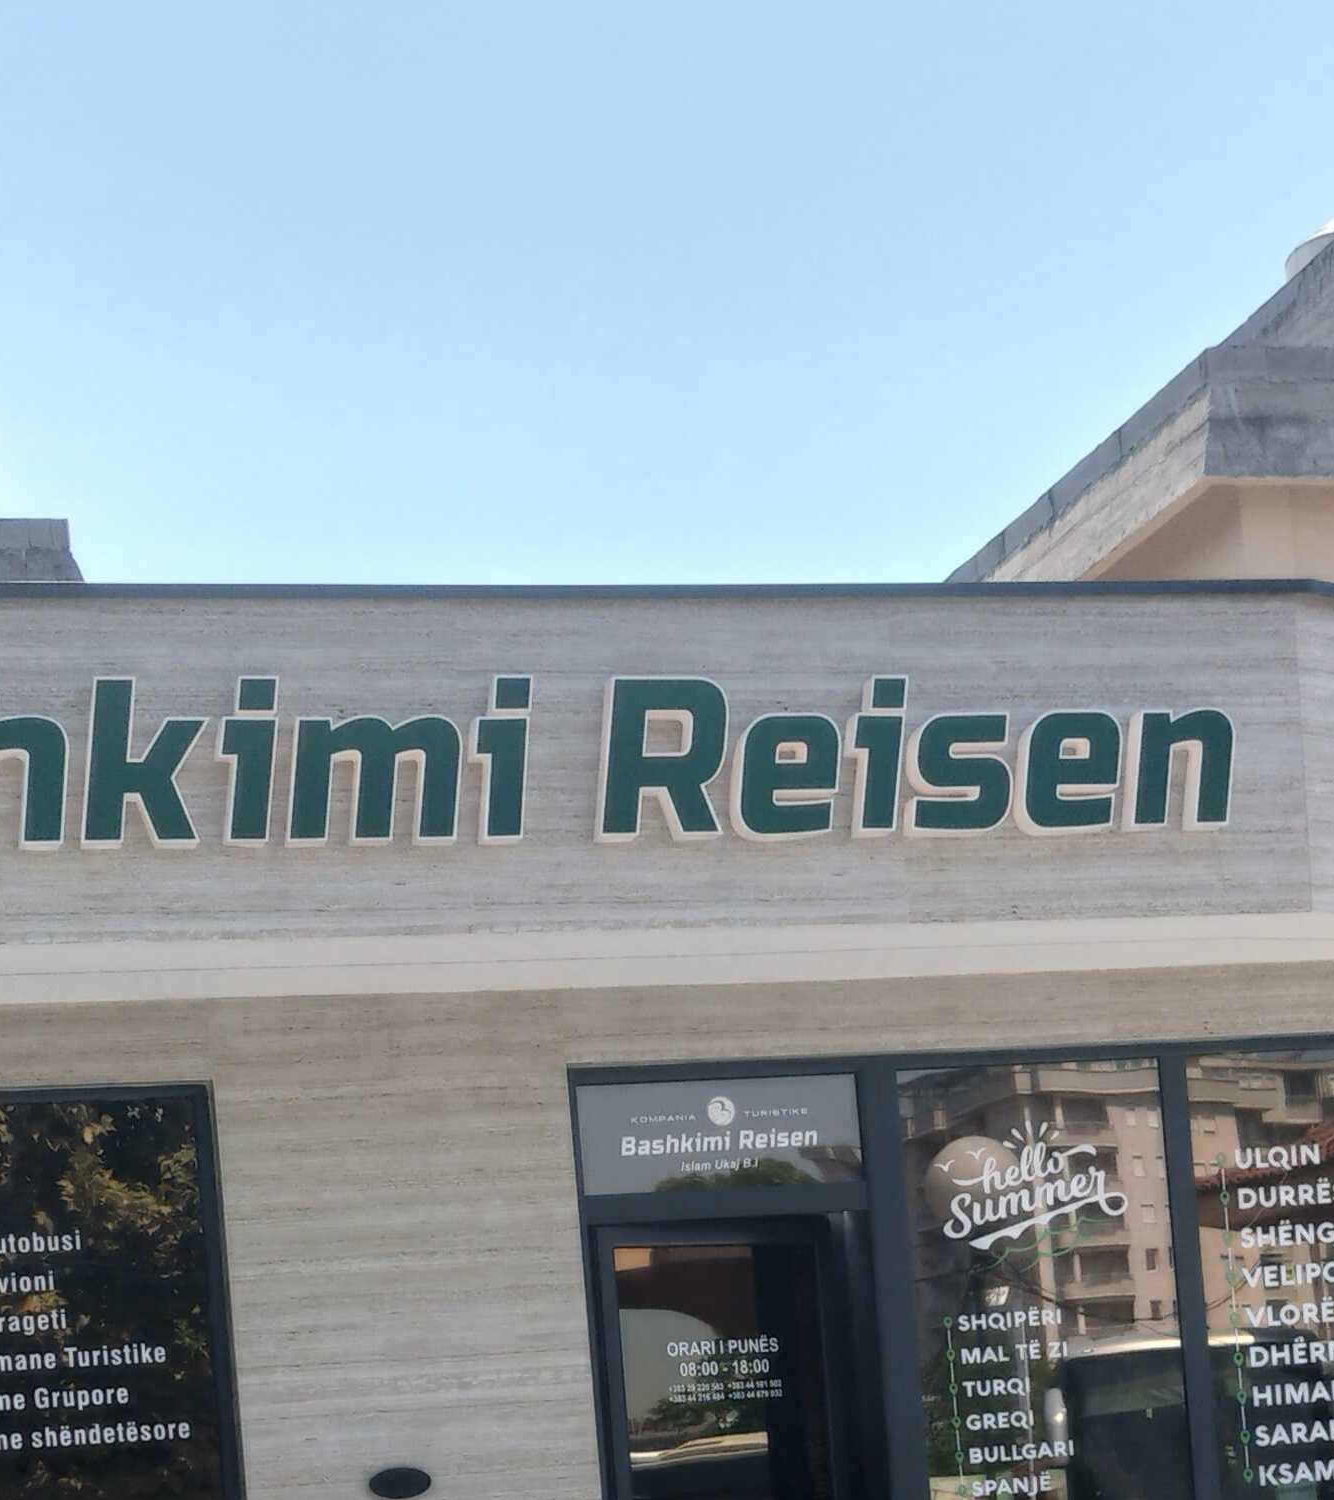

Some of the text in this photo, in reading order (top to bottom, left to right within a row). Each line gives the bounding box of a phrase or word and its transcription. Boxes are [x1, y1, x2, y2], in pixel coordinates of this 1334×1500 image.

[595, 673, 1235, 846] Reisen
[631, 1114, 696, 1124] KOMPANIA
[621, 1128, 818, 1156] Bashkimi Reisen
[681, 1160, 711, 1172] Islam
[715, 1159, 740, 1171] Ukaj
[953, 1141, 1096, 1194] hello
[1235, 1144, 1320, 1170] ULQIN
[958, 1306, 1062, 1332] SHQIPËRI
[64, 1343, 166, 1368] Turistike
[667, 1334, 779, 1357] ORARI I PUNËS
[961, 1339, 1067, 1364] MAL TË ZI
[679, 1361, 719, 1376] 08:00
[732, 1359, 769, 1374] 18:00
[34, 1387, 129, 1410] Grupore
[962, 1376, 1030, 1398] TURQI
[966, 1410, 1034, 1431] GREQI
[31, 1421, 190, 1448] shëndetësore
[969, 1439, 1075, 1465] BULLGARI
[971, 1471, 1052, 1497] SPANJË
